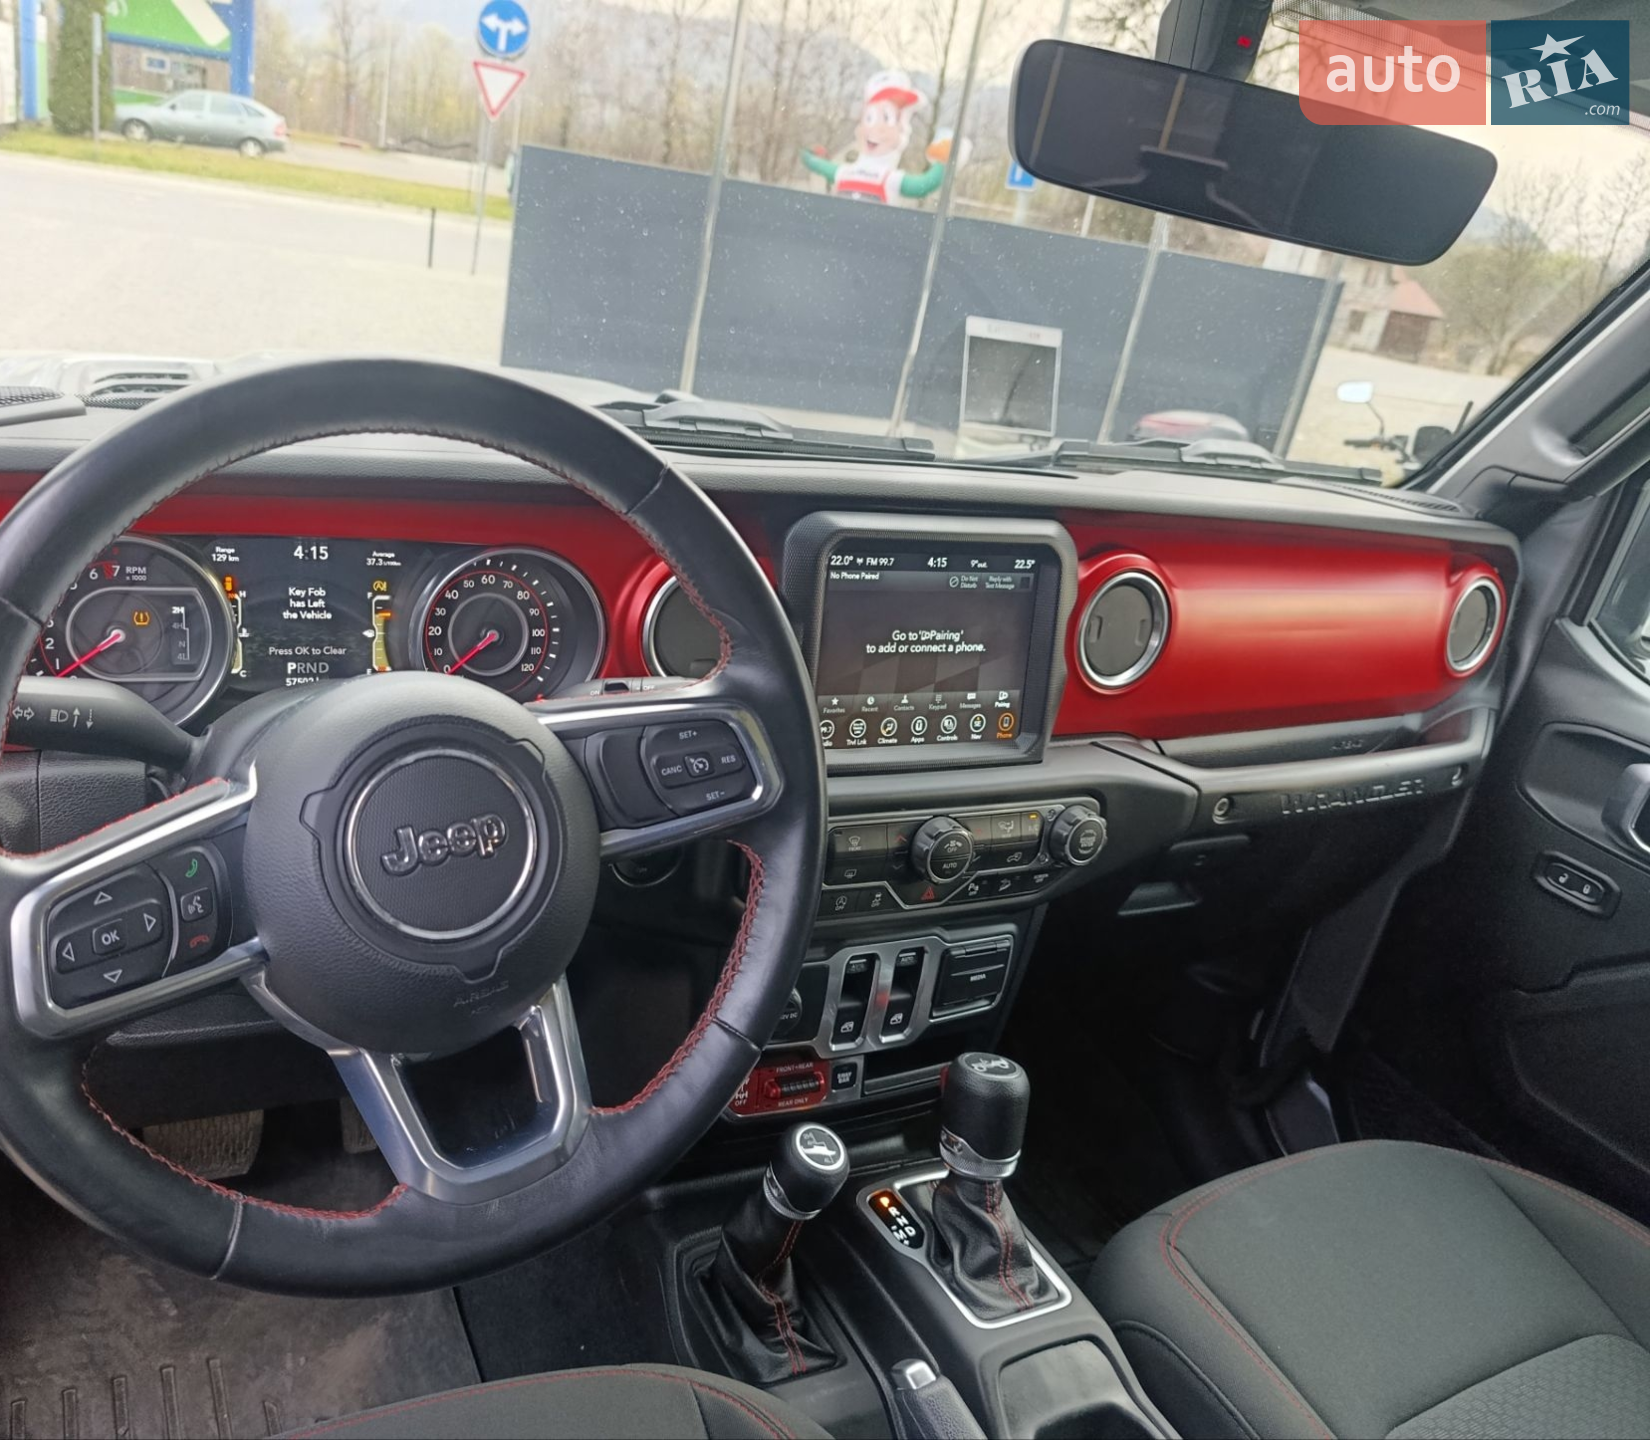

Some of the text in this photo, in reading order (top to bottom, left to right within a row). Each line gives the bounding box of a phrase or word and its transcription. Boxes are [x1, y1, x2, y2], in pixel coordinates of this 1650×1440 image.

[215, 546, 235, 555] Range
[293, 546, 329, 560] 4:15
[372, 551, 395, 559] Average
[211, 554, 227, 562] 129
[366, 558, 383, 566] 37.3
[866, 557, 878, 566] FM
[879, 557, 894, 567] 99.7
[927, 557, 948, 568] 4:15
[89, 569, 98, 580] 6
[112, 565, 120, 577] 7
[126, 567, 147, 575] RPM
[463, 580, 475, 588] 50
[481, 575, 496, 585] 60
[502, 580, 513, 589] 70
[289, 587, 326, 598] Key Fob
[445, 590, 459, 600] 40
[517, 590, 530, 600] 80
[290, 599, 325, 608] has Left
[282, 610, 332, 619] the Vehicle
[435, 608, 446, 617] 30
[529, 608, 540, 617] 90
[428, 626, 442, 636] 20
[532, 629, 545, 637] 100
[892, 630, 906, 641] Go
[908, 631, 918, 640] to
[45, 638, 54, 649] 2
[866, 644, 876, 653] to
[878, 643, 895, 653] add
[898, 645, 909, 653] or
[910, 643, 947, 653] connect
[955, 643, 986, 653] phone.
[268, 646, 347, 655] Press OK to Clear
[434, 648, 443, 656] 10
[530, 647, 541, 655] 110
[521, 663, 535, 672] 120
[679, 730, 698, 740] SET+
[721, 754, 736, 764] RES
[661, 765, 682, 776] CANC
[381, 813, 507, 876] Jeep
[101, 929, 120, 945] OK
[970, 974, 986, 982] MEDIA
[735, 1099, 747, 1107] OFF
[778, 1097, 809, 1107] REAR ONLY
[905, 1226, 916, 1237] D
